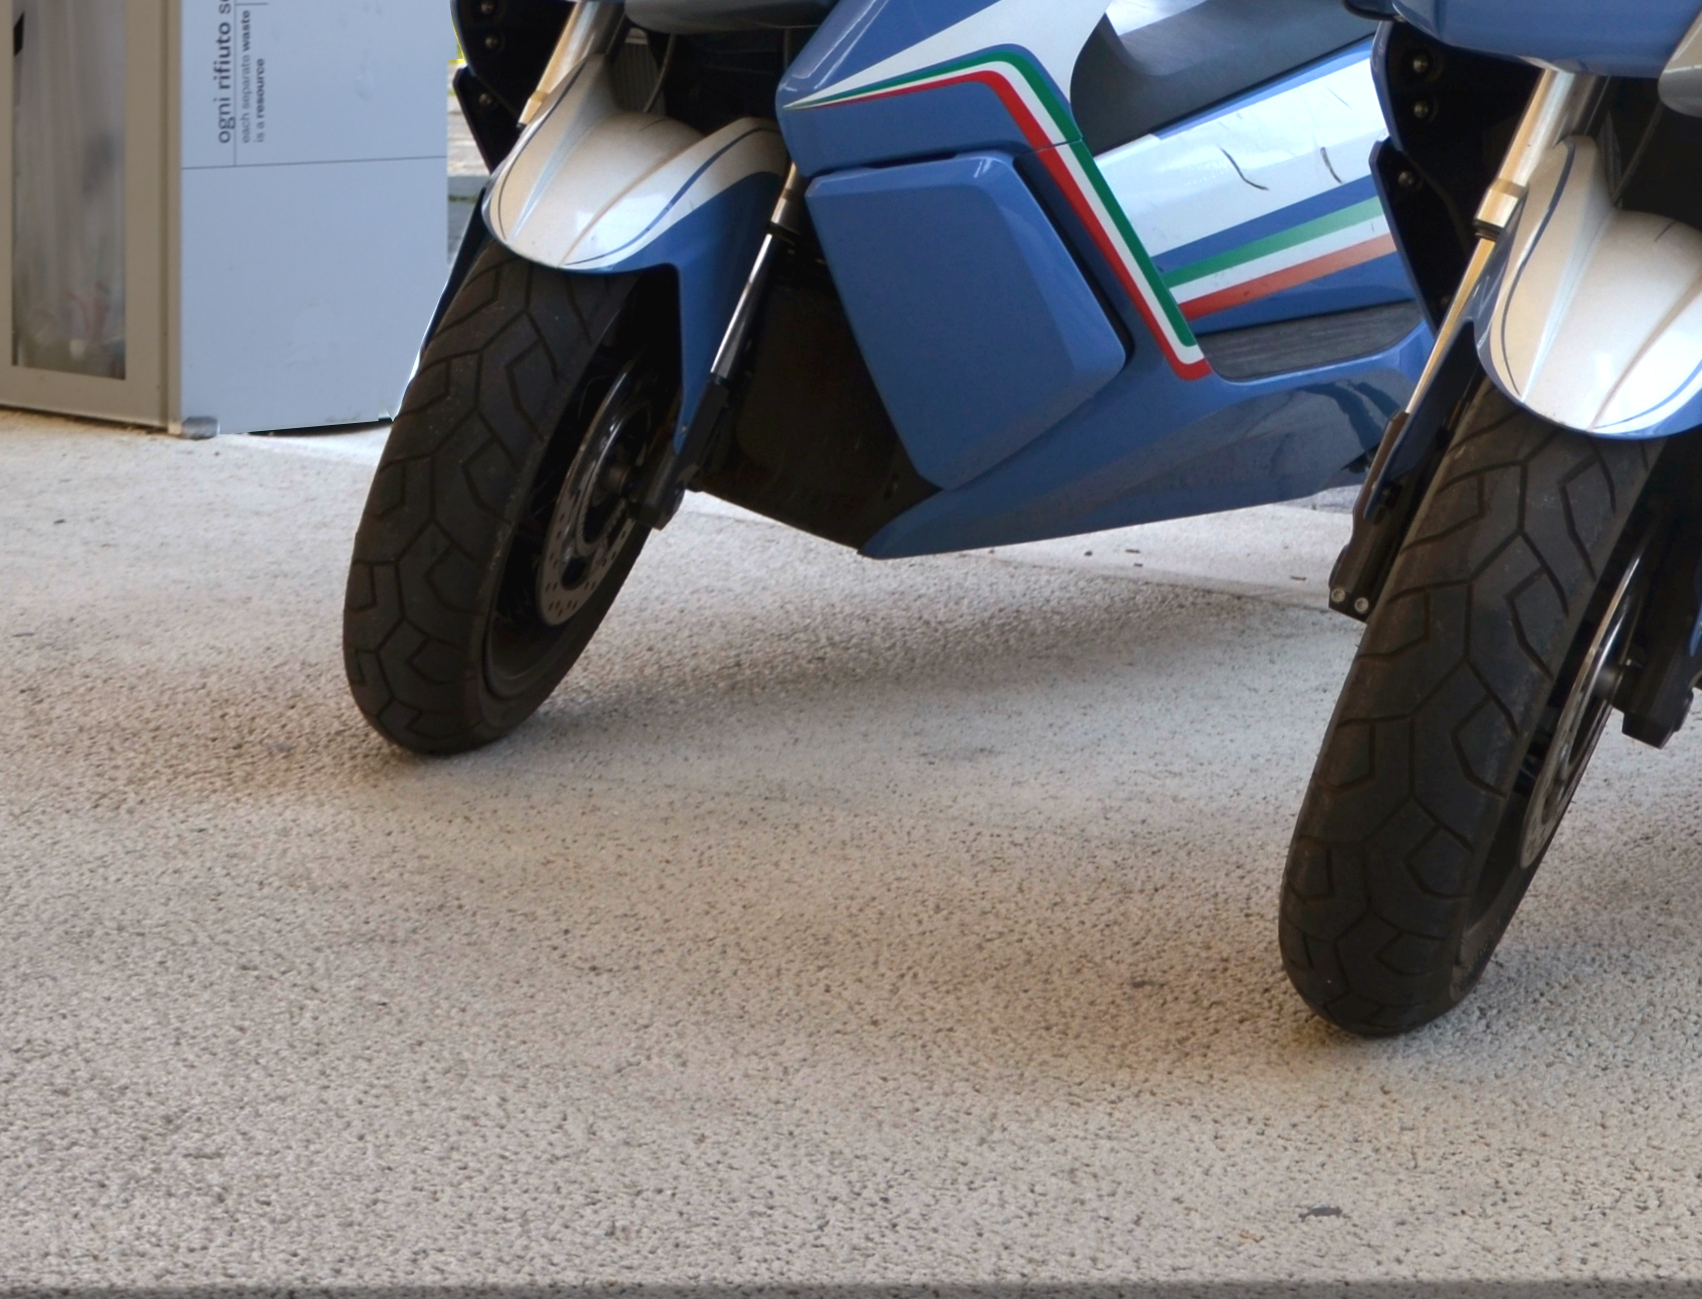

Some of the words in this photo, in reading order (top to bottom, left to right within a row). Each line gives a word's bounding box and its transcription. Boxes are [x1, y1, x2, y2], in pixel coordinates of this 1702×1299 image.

[241, 10, 251, 52] waste
[212, 21, 232, 90] rifiuto
[240, 54, 254, 110] separate
[256, 58, 265, 119] resource
[212, 97, 236, 144] ogni
[239, 112, 251, 144] each
[257, 121, 265, 130] a
